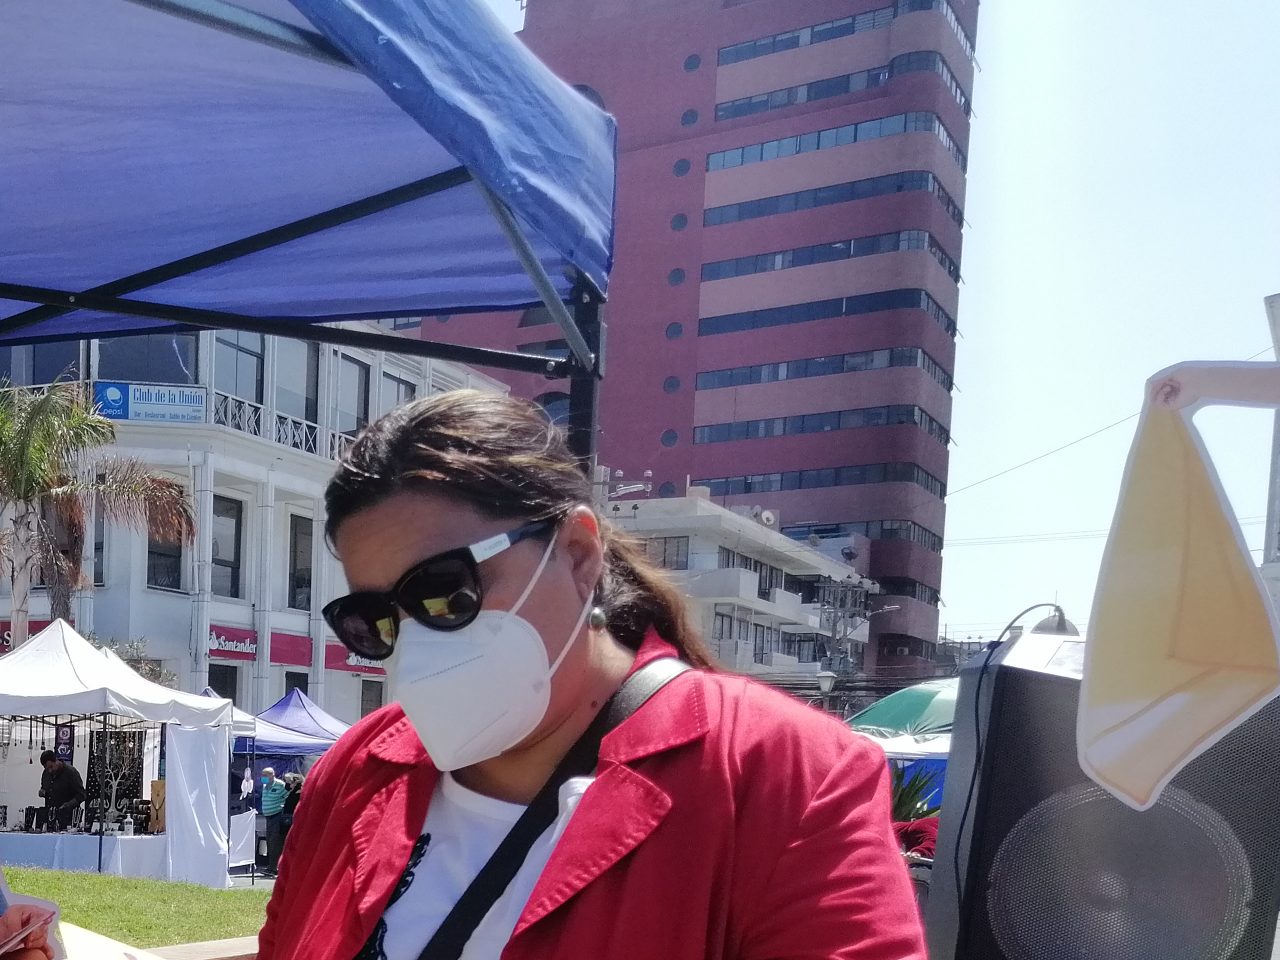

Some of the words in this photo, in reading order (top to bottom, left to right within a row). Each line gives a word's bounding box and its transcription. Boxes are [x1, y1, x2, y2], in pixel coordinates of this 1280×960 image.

[133, 387, 153, 402] Club
[155, 389, 166, 403] de
[168, 390, 176, 404] la
[178, 390, 203, 406] Unión
[103, 408, 123, 417] pepsi
[220, 635, 257, 653] Santander
